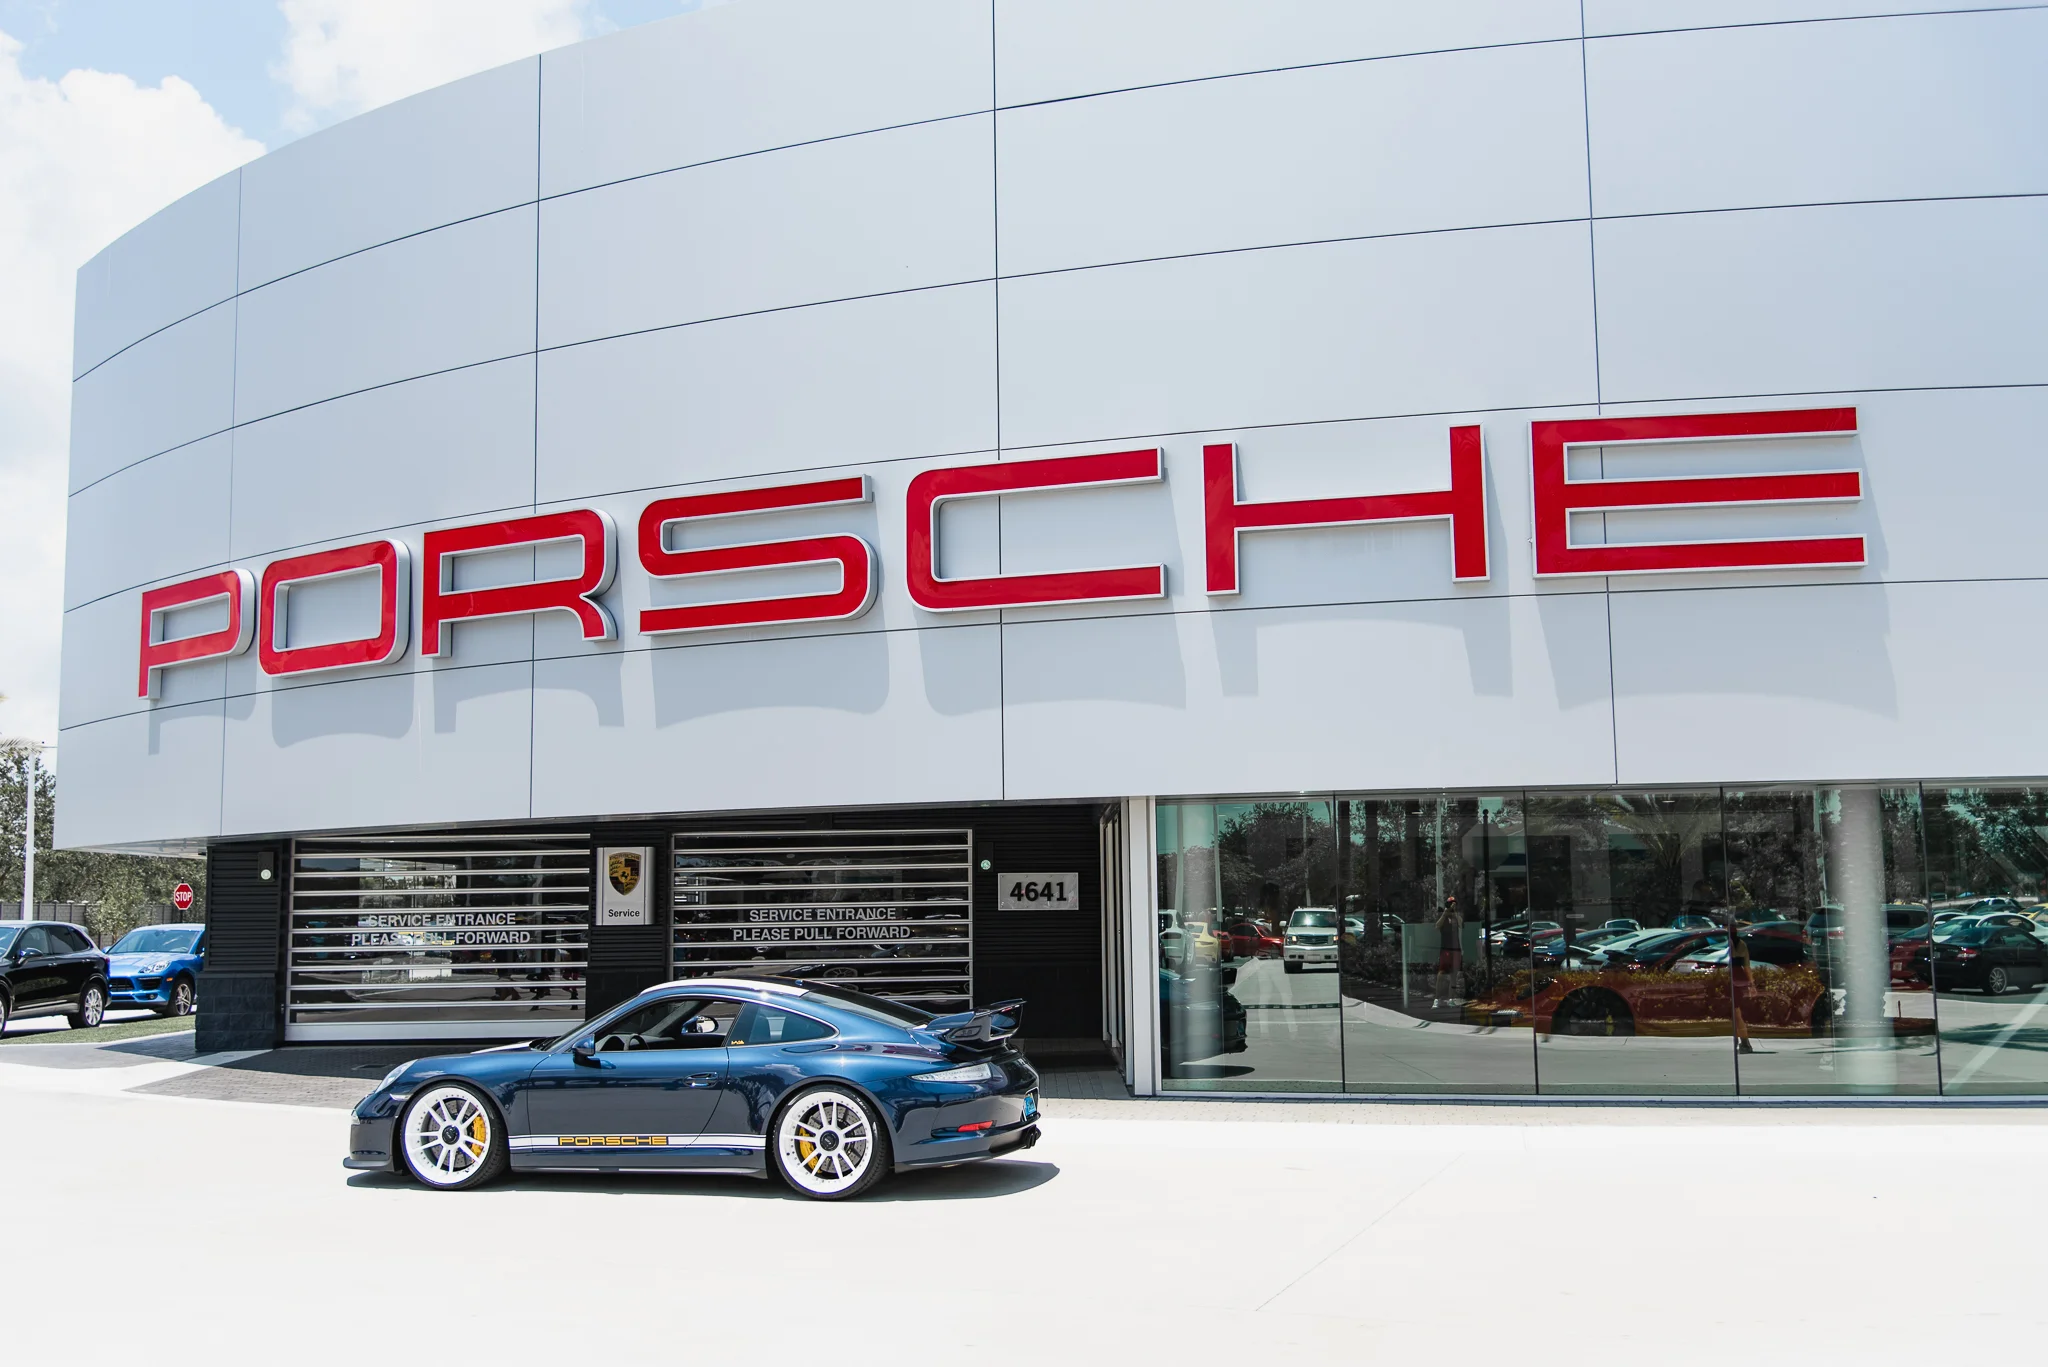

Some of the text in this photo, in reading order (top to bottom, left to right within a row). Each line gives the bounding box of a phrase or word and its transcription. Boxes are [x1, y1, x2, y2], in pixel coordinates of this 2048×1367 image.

[137, 406, 1868, 701] PORSCHE
[175, 891, 192, 902] STOP
[1009, 881, 1067, 902] 4641
[369, 913, 516, 927] SERVICE ENTRANCE
[608, 908, 640, 918] Service
[749, 908, 896, 922] SERVICE ENTRANCE
[352, 933, 409, 946] PLEASE
[456, 931, 531, 944] FORWARD
[733, 926, 911, 941] PLEASE PULL FORWARD
[559, 1136, 667, 1146] PORSCHE
